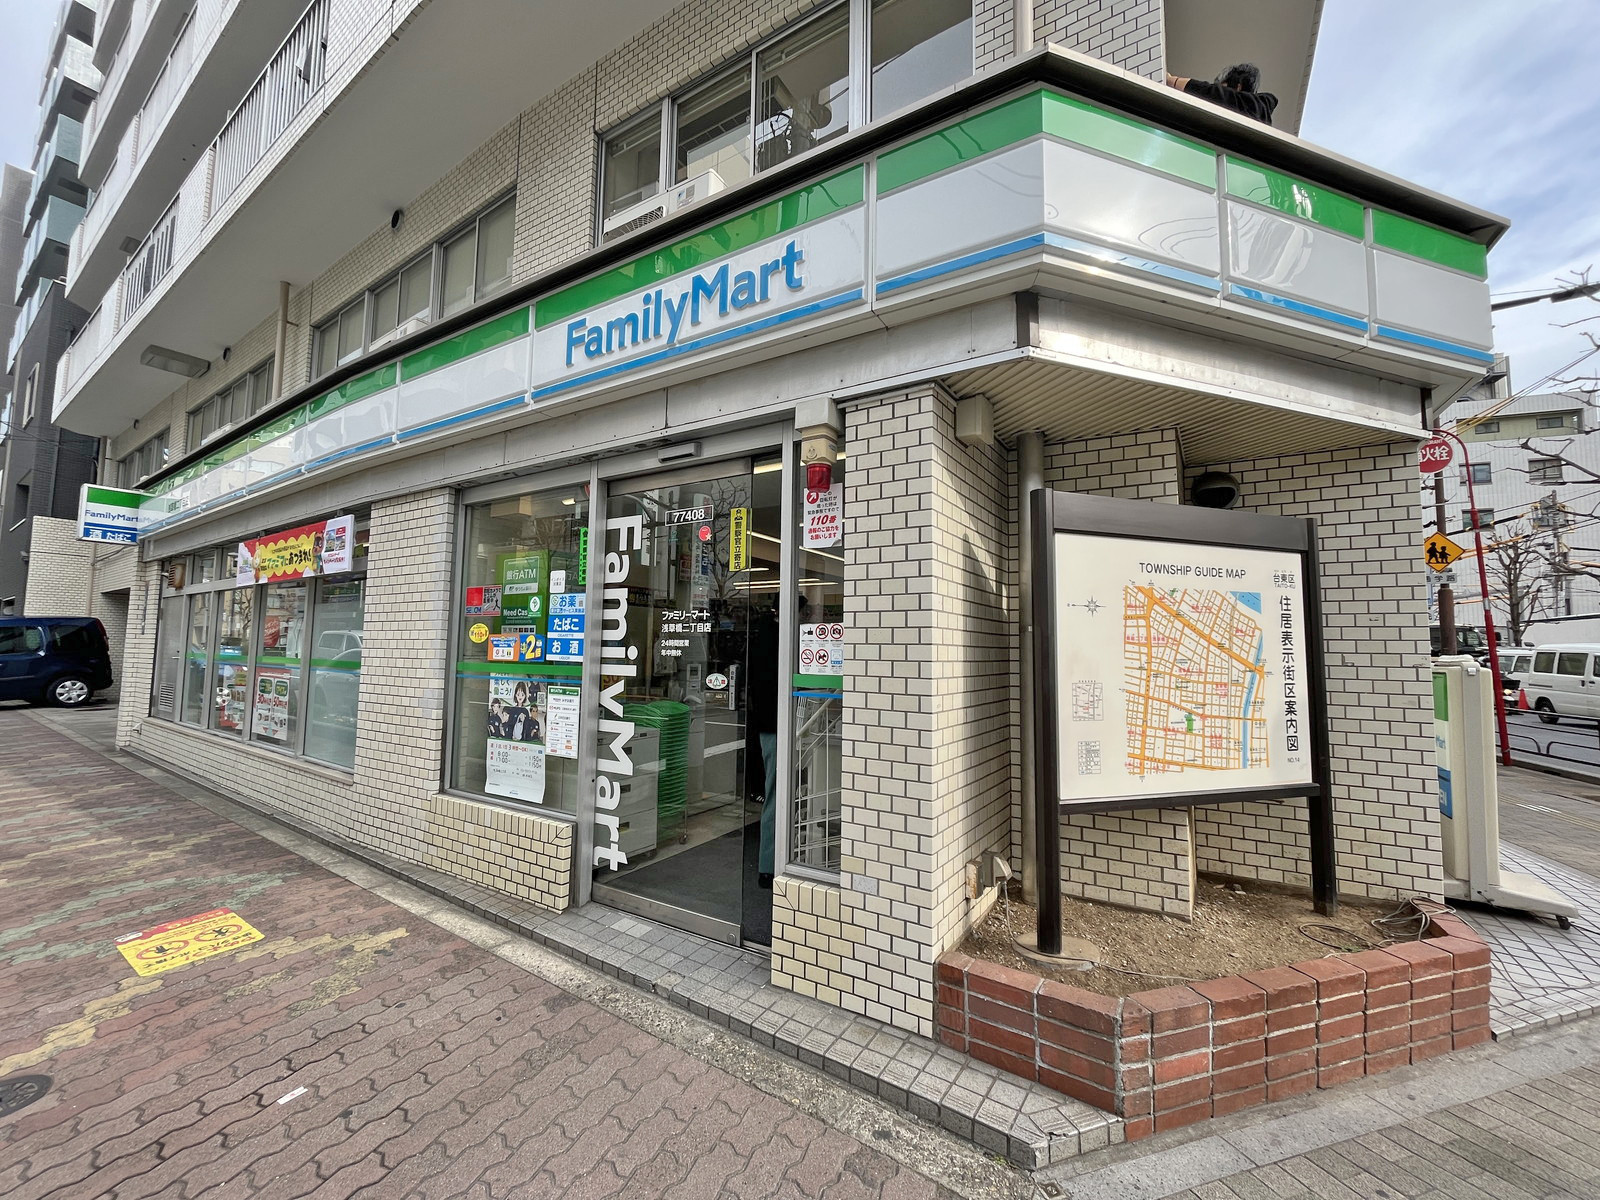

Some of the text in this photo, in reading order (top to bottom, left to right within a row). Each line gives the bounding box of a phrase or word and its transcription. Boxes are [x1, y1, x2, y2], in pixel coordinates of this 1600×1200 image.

[565, 240, 805, 367] FamilyMart
[85, 509, 139, 523] FamilyMart
[673, 508, 705, 523] 77408
[810, 514, 837, 526] 110番
[89, 529, 132, 542] 酒 たばこ
[506, 568, 537, 580] 銀行ATM
[1139, 562, 1246, 579] TOWNSHIP GUIDE MAP
[1273, 573, 1295, 584] 台東区
[559, 595, 577, 607] お薬
[503, 609, 517, 617] Need
[661, 609, 711, 621] ファミリーマート
[553, 617, 580, 631] たばこ
[661, 622, 712, 633] 浅草橋二丁目店
[552, 640, 580, 654] お酒
[660, 639, 690, 647] 24時間営業
[660, 649, 682, 657] 年中無休
[1279, 595, 1299, 752] 住居表示街区案内図
[593, 514, 643, 872] FamilyMart
